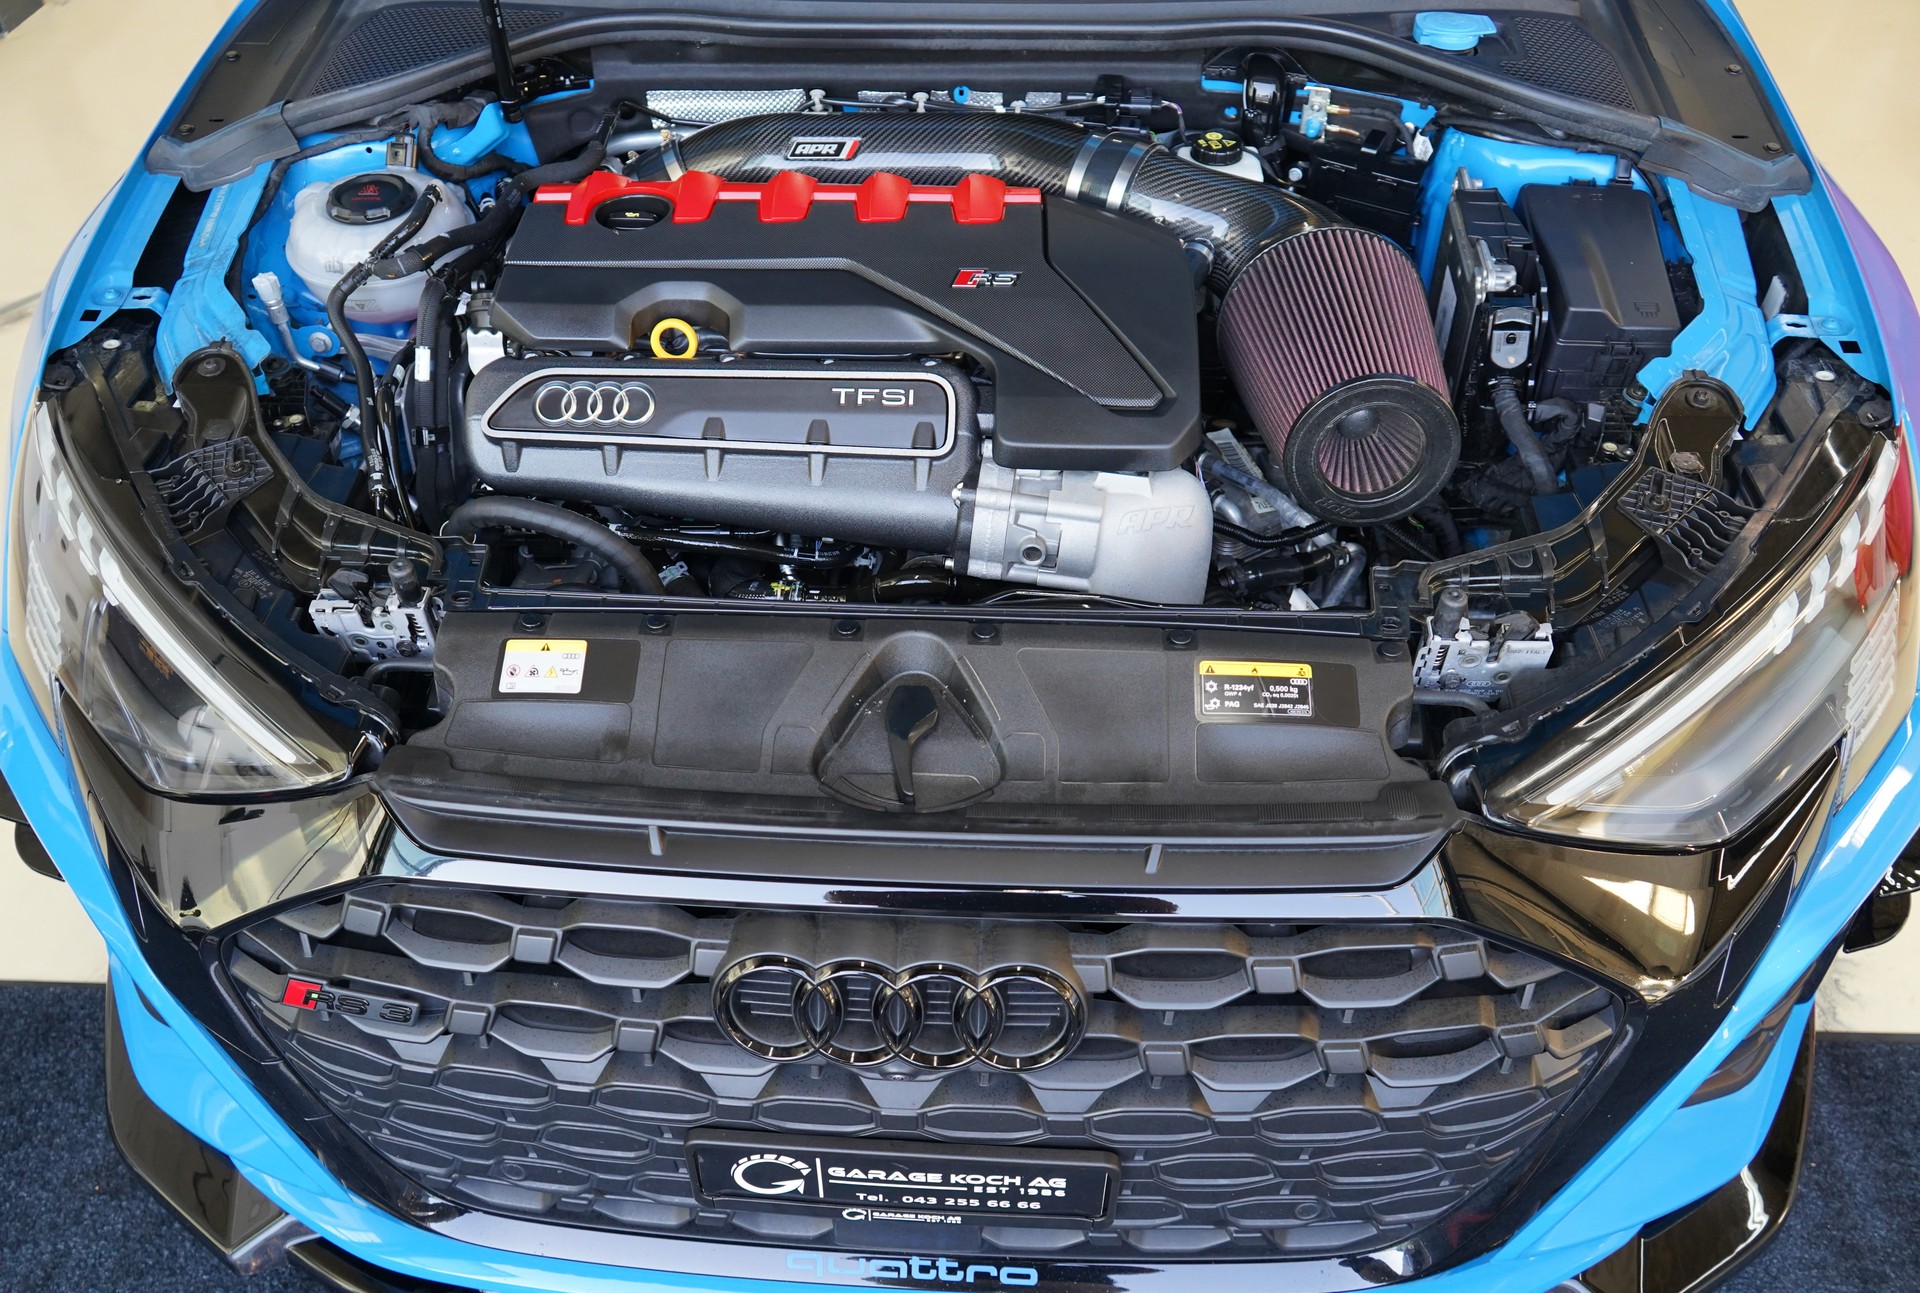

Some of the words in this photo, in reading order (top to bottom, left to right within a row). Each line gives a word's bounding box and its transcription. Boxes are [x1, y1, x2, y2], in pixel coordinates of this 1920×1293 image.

[794, 143, 839, 155] APR
[957, 271, 1018, 287] RS
[831, 387, 914, 406] TFSI
[1116, 505, 1195, 535] APR
[1223, 683, 1255, 693] R-1234yf
[1289, 686, 1299, 694] kg
[292, 983, 371, 1016] RS
[379, 1002, 413, 1024] 3
[827, 1166, 943, 1183] GARAGE
[950, 1173, 1022, 1187] KOCH
[1028, 1176, 1067, 1189] AG
[973, 1186, 1010, 1195] EST
[1019, 1187, 1067, 1198] 1986
[855, 1192, 890, 1202] Tel.
[901, 1195, 938, 1205] 043
[944, 1197, 981, 1207] 255
[986, 1199, 1011, 1209] 66
[1017, 1201, 1042, 1210] 66
[872, 1211, 916, 1219] GARAGE
[786, 1253, 1039, 1287] quattro
